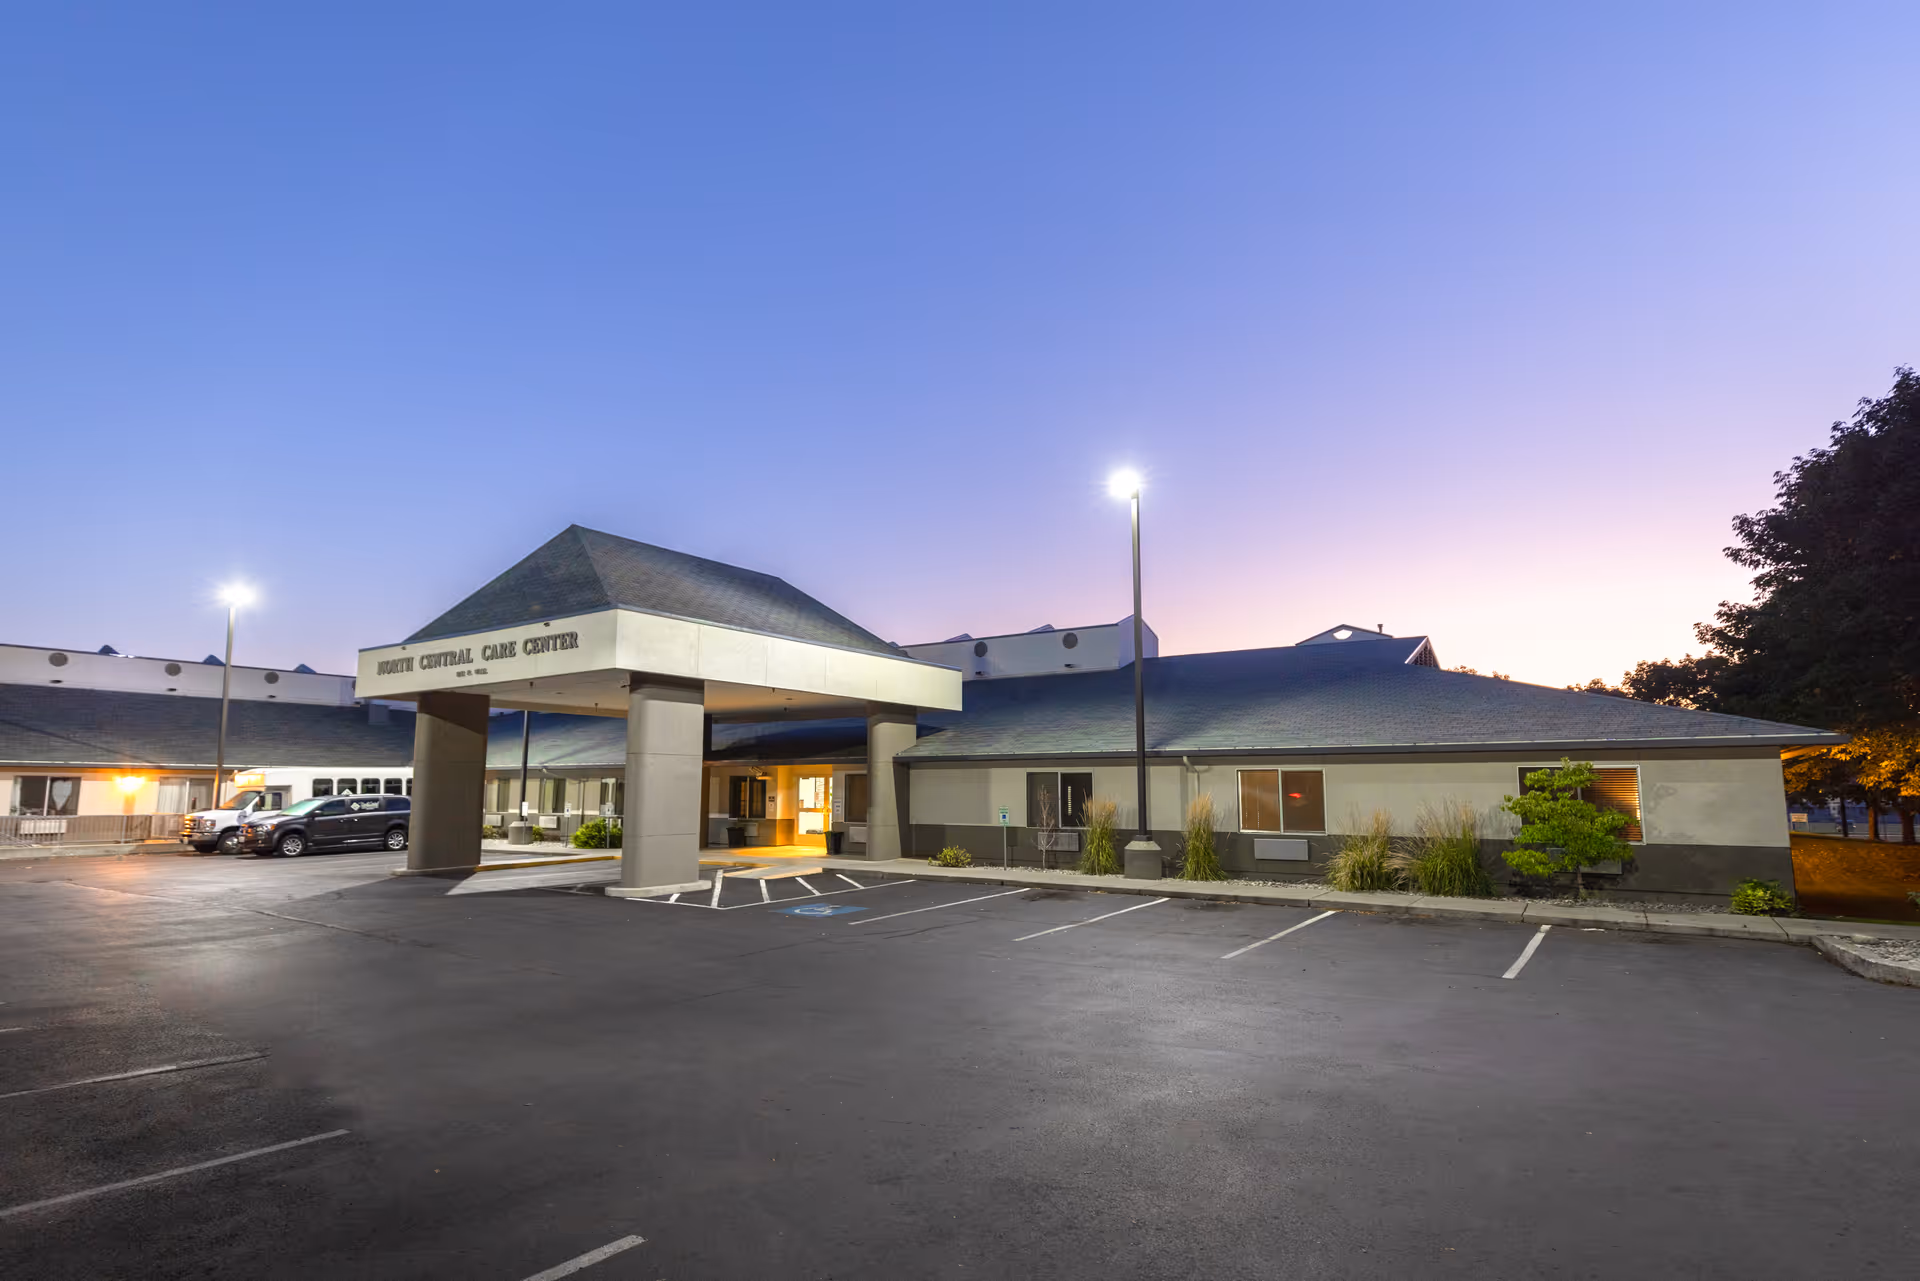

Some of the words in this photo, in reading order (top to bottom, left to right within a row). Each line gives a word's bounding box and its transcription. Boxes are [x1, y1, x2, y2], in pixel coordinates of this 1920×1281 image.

[376, 656, 414, 676] NORTH
[418, 648, 473, 670] CENTRAL
[481, 641, 517, 661] CARE
[522, 631, 579, 656] CENTER
